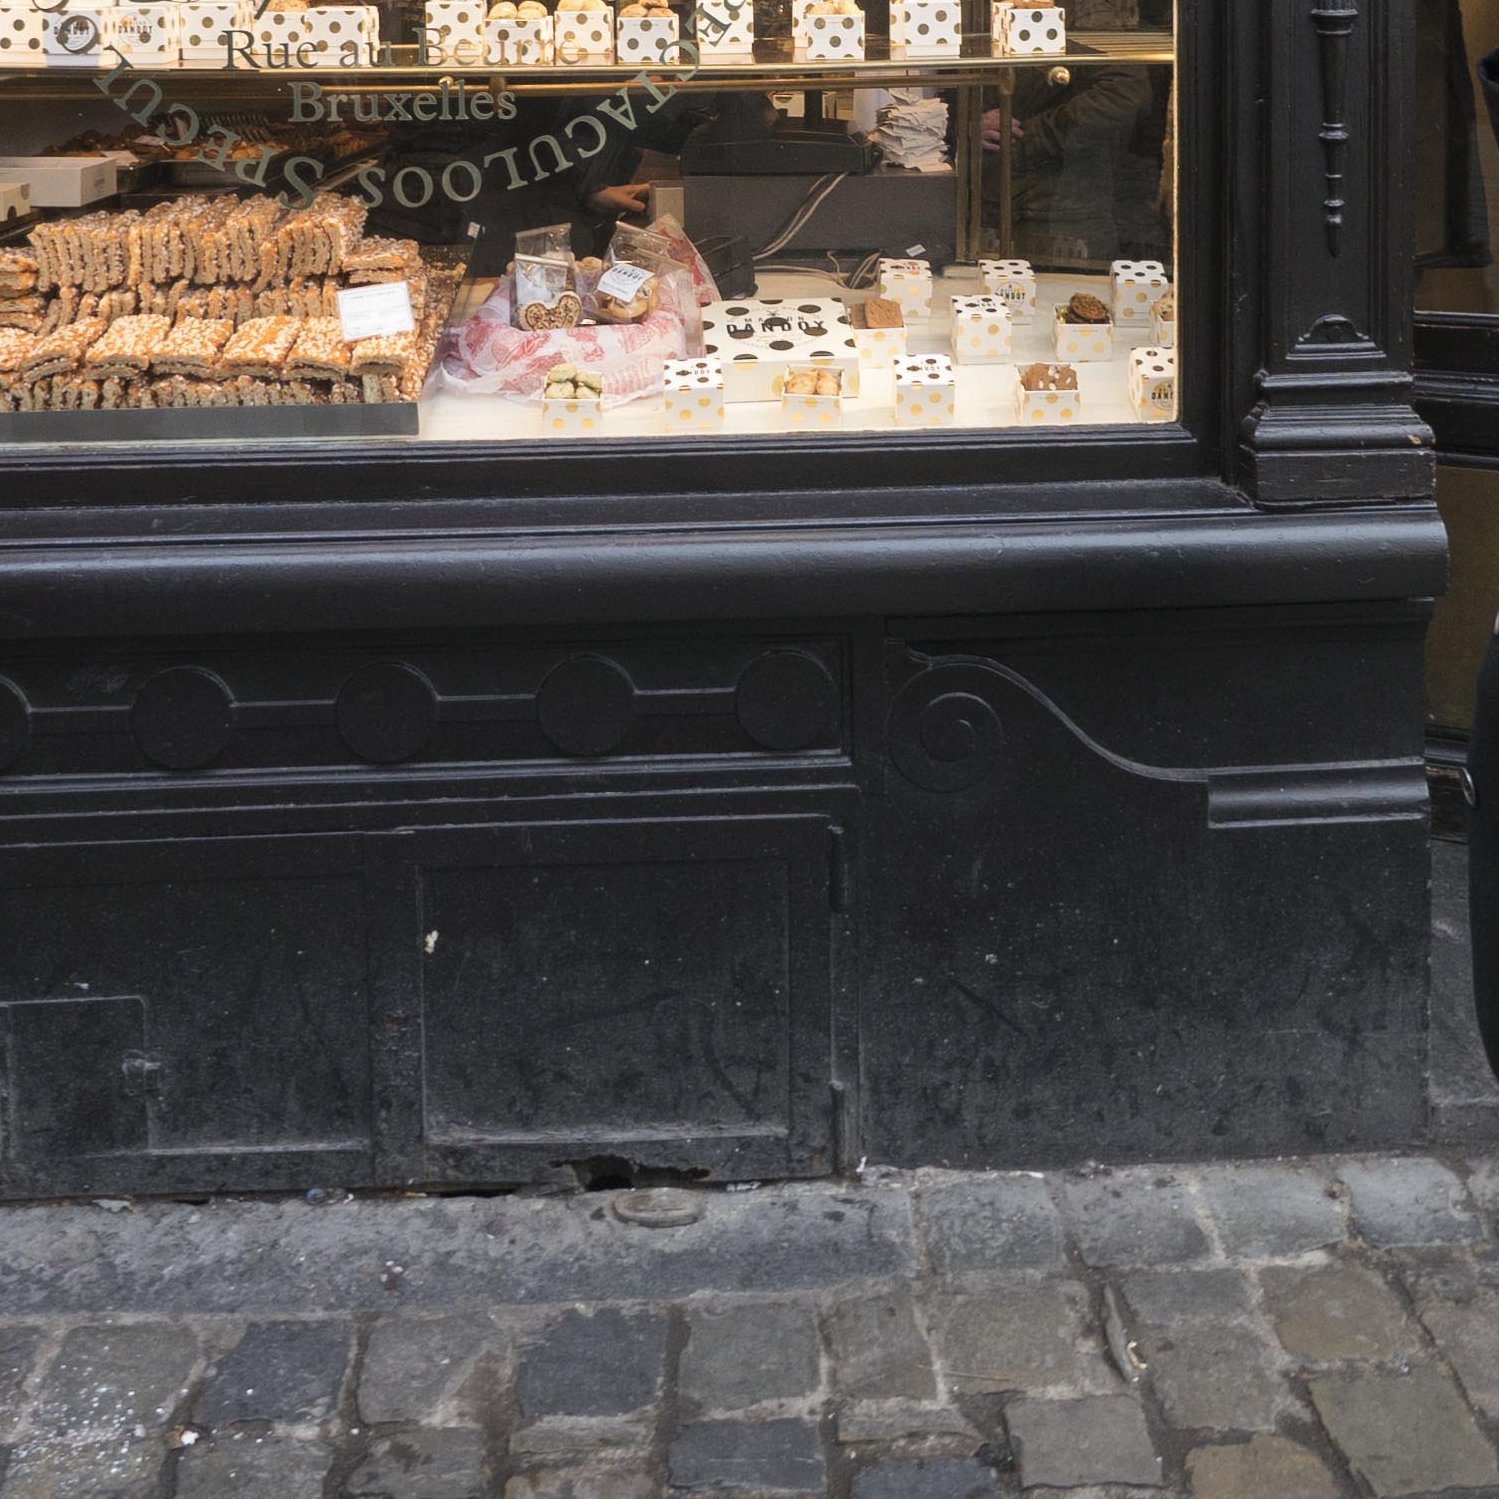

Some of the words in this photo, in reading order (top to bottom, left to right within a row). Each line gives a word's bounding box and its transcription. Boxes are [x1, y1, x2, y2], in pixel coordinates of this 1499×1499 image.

[221, 28, 321, 70] Rue
[338, 39, 397, 69] au
[411, 26, 582, 68] Beurre
[286, 79, 519, 124] Bruxelles
[726, 320, 826, 336] DANDOY
